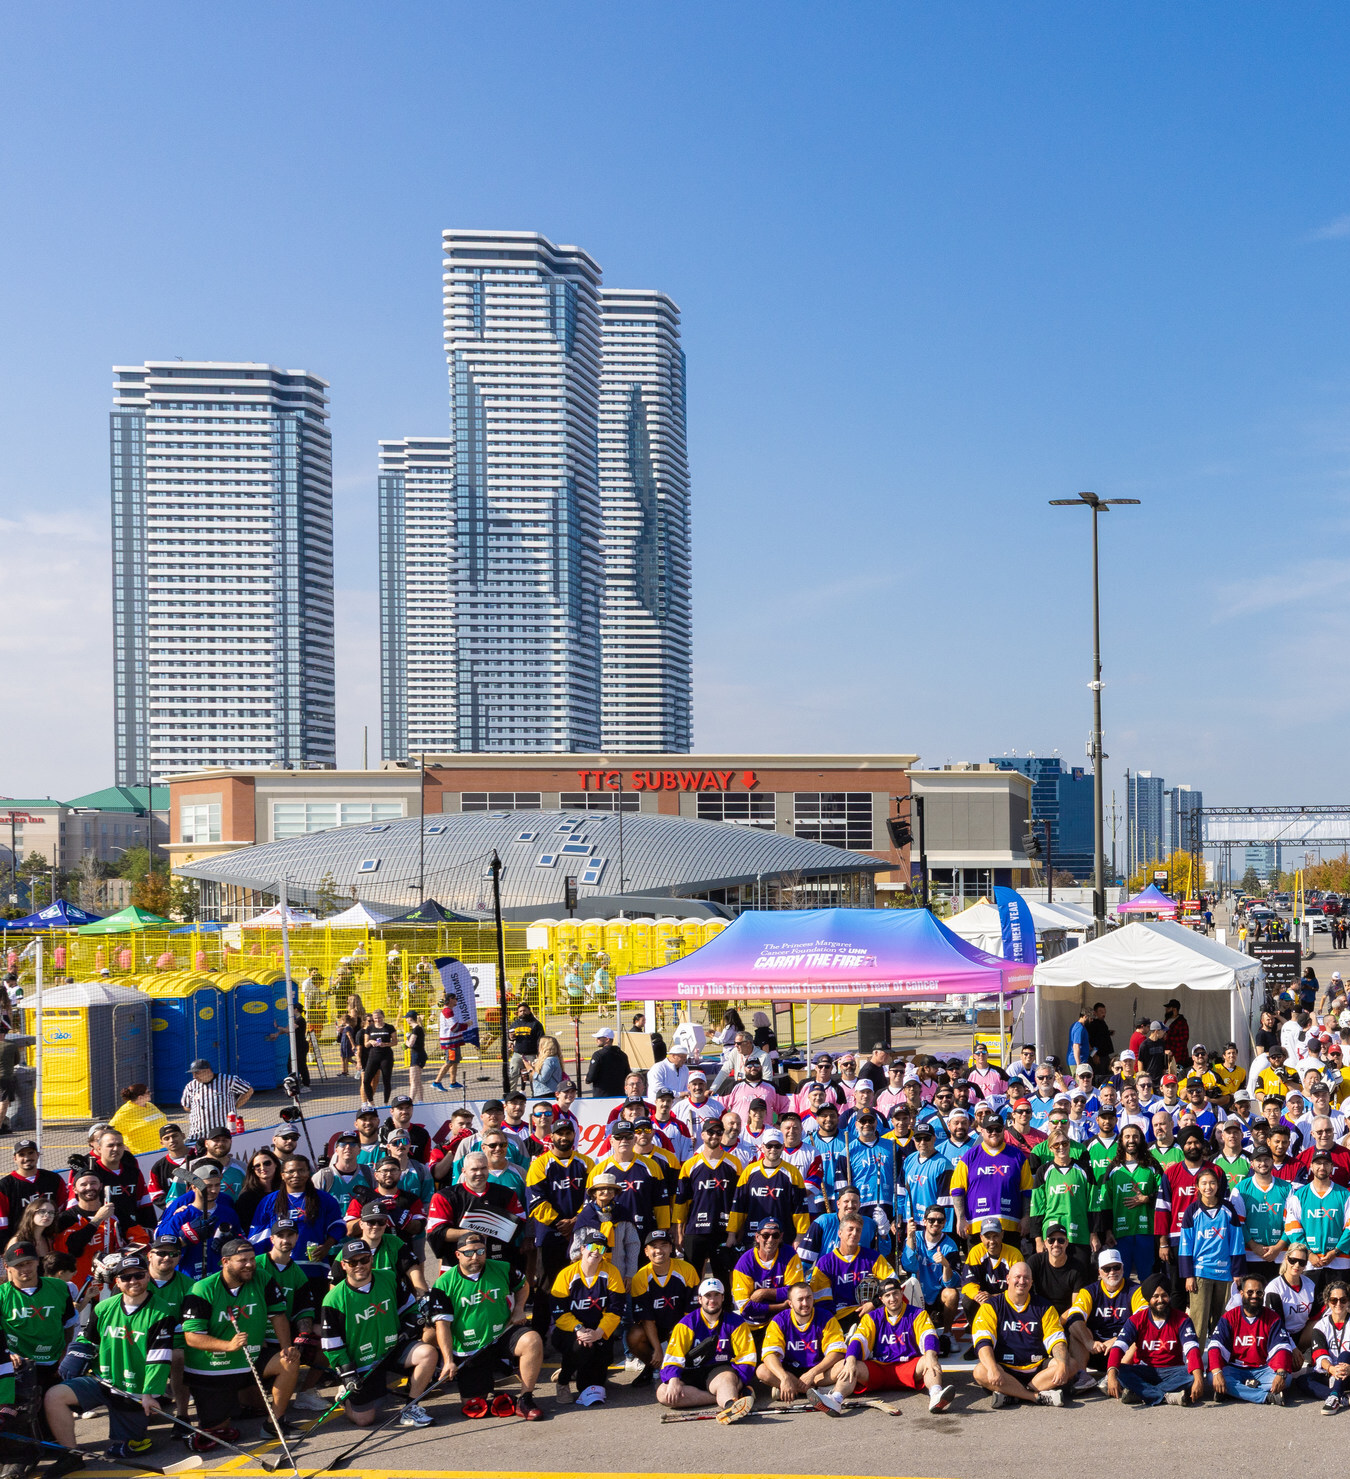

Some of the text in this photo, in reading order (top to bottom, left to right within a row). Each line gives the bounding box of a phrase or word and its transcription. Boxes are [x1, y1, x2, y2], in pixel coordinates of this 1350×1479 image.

[577, 771, 734, 790] TTC SUBWAY
[1009, 901, 1018, 922] YEAR
[1011, 923, 1022, 941] NEXT
[779, 941, 814, 949] Princess
[815, 940, 852, 949] Margaret
[790, 947, 836, 955] Foundation
[754, 954, 863, 968] CARRY THE FIRE
[677, 982, 704, 996] Carry
[706, 982, 724, 994] The
[726, 982, 745, 994] Fire
[746, 983, 761, 994] for
[772, 982, 800, 994] world
[803, 982, 823, 993] free
[825, 982, 849, 993] from
[851, 981, 868, 992] the
[870, 980, 890, 992] fear
[892, 980, 903, 991] of
[904, 979, 939, 992] cancer
[450, 972, 471, 1023] WASHROOMS
[977, 1164, 1010, 1176] NEXT
[109, 1184, 137, 1196] NEXT
[220, 1182, 241, 1192] EXT
[553, 1176, 583, 1191] NEXT
[617, 1179, 644, 1192] EXT
[698, 1177, 730, 1191] NEXT
[1050, 1182, 1081, 1196] NEXT
[1116, 1181, 1148, 1194] NEXT
[751, 1185, 784, 1200] NEXT
[1251, 1202, 1283, 1215] NEXT
[1307, 1207, 1339, 1220] NEXT
[1198, 1226, 1227, 1240] NEXT
[754, 1274, 784, 1290] NEXT
[838, 1270, 869, 1284] NEXT
[461, 1288, 500, 1308] NEXT
[570, 1295, 607, 1311] NEXT
[12, 1306, 55, 1320] NEXT
[218, 1303, 257, 1323] NEXT
[354, 1299, 391, 1324] NEXT
[1095, 1307, 1127, 1319] NEXT
[1289, 1301, 1313, 1315] NEXT
[1002, 1320, 1038, 1335] NEXT
[103, 1326, 145, 1345] NEXT
[880, 1331, 909, 1346] NEXT
[1235, 1335, 1265, 1347] NEXT
[787, 1339, 818, 1353] NEXT
[1142, 1339, 1177, 1351] NEXT
